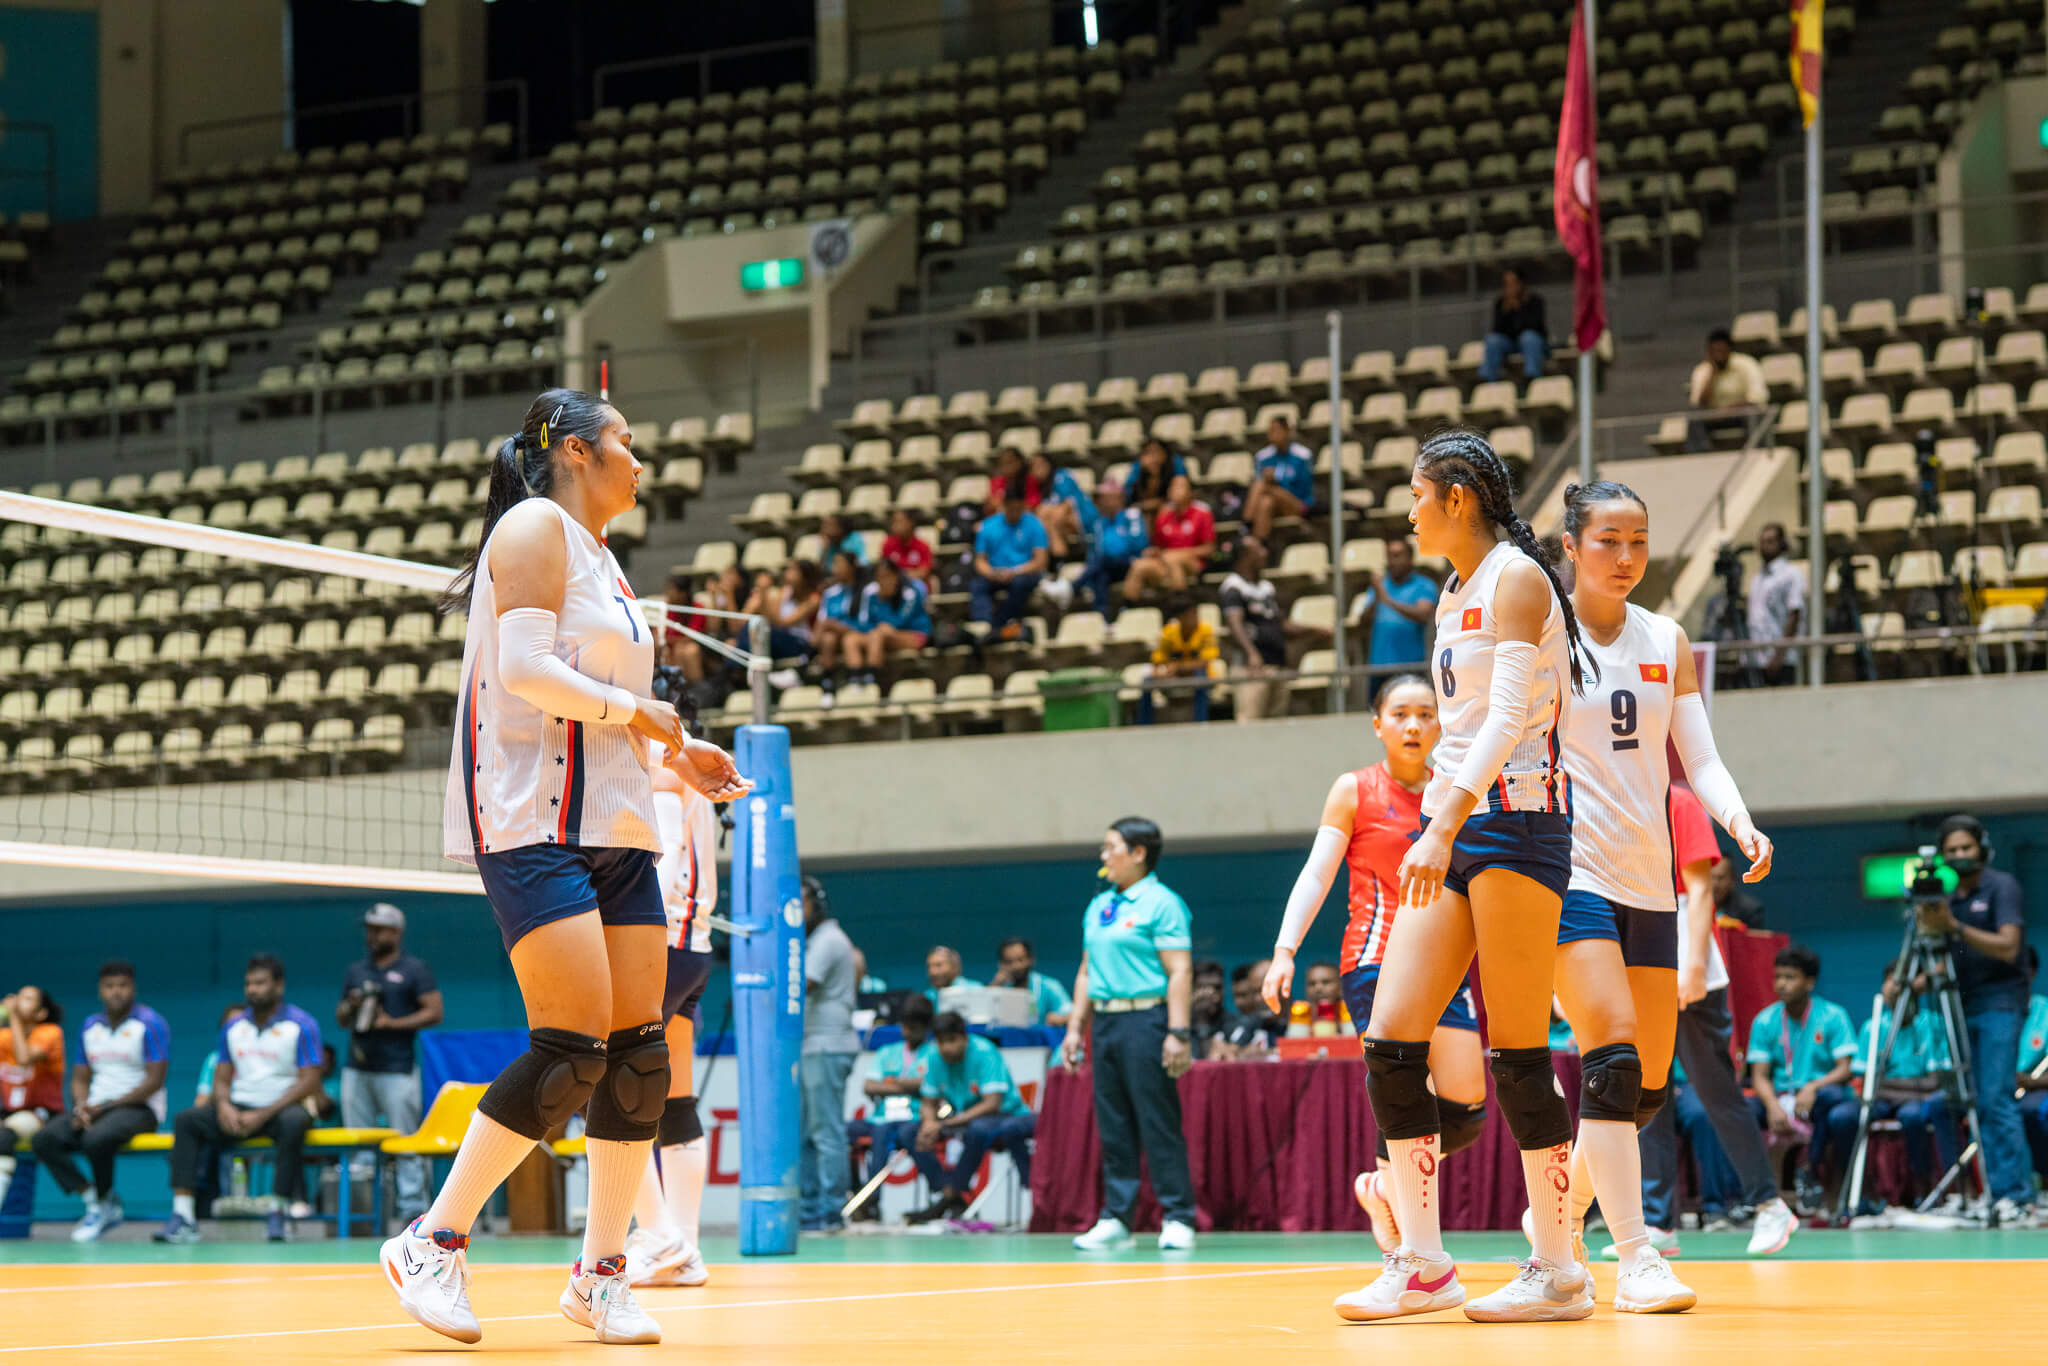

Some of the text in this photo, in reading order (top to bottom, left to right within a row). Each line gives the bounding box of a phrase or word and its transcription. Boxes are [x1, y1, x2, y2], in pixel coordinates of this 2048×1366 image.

[614, 594, 640, 644] 7
[1439, 647, 1456, 698] 8
[1610, 689, 1637, 737] 9
